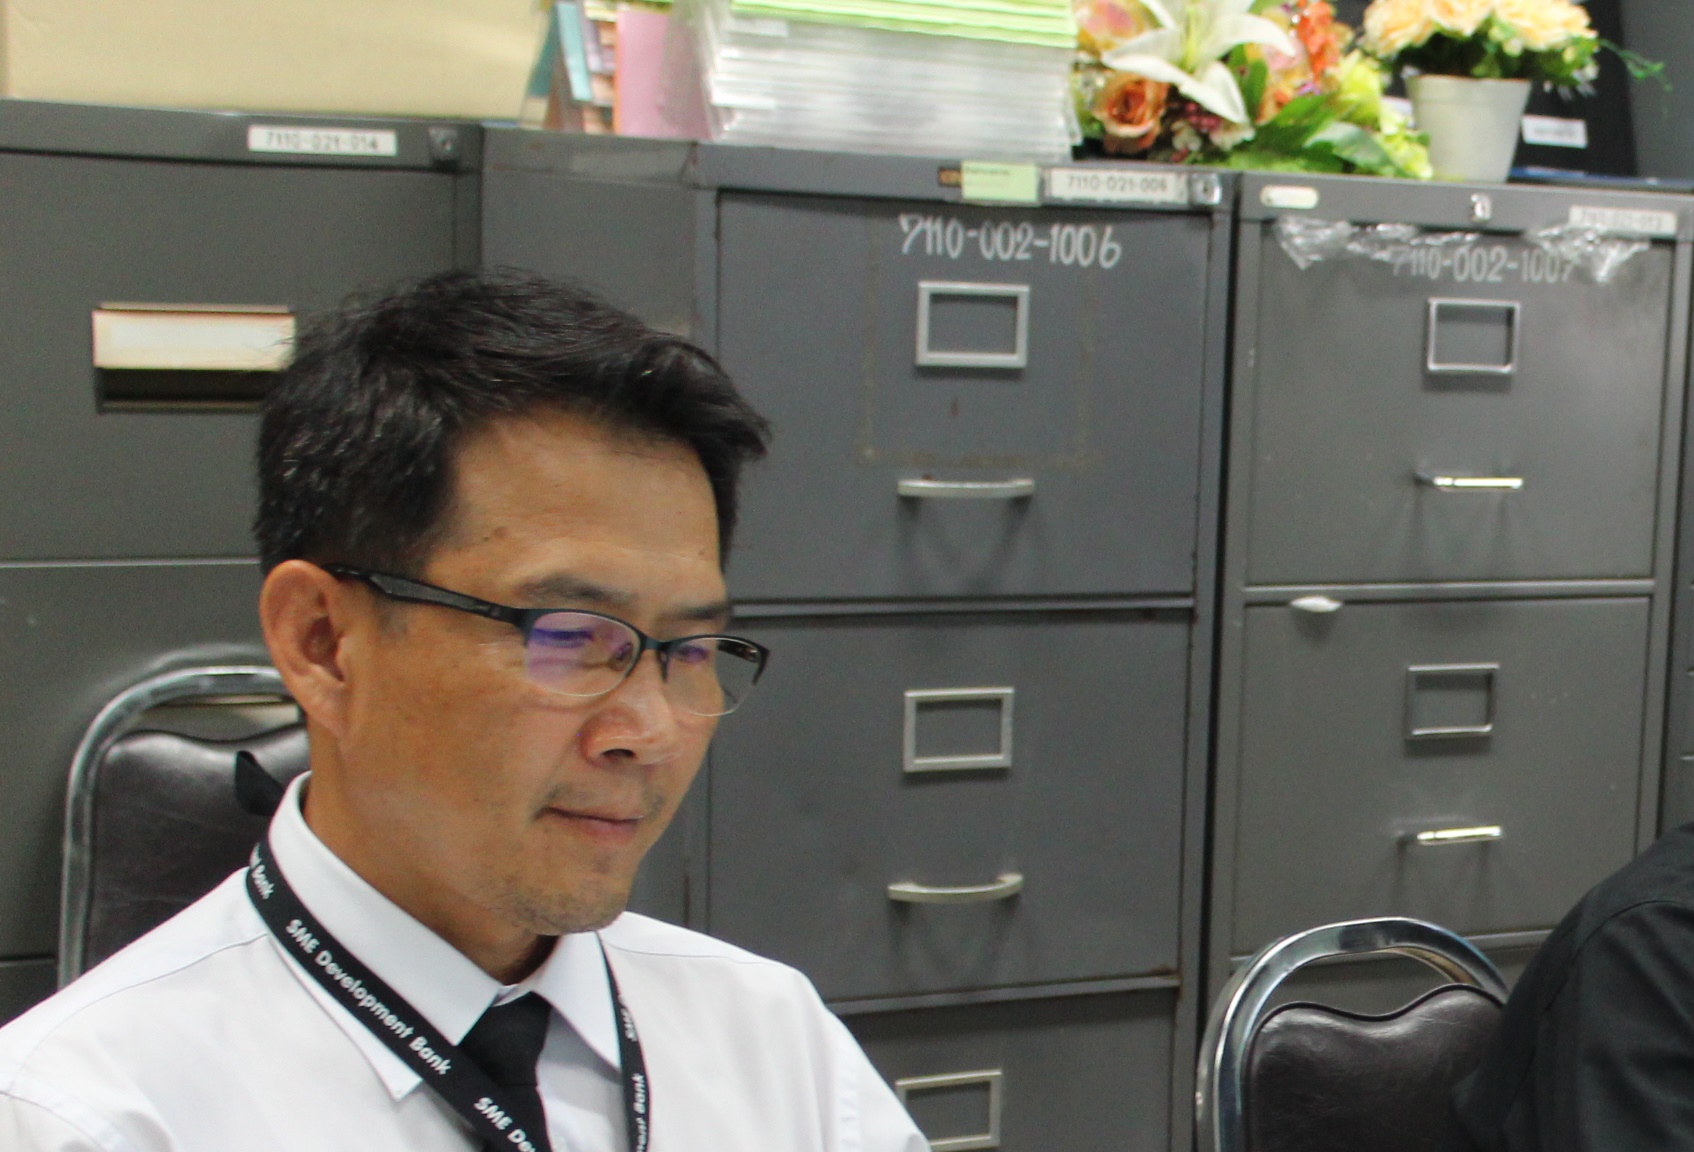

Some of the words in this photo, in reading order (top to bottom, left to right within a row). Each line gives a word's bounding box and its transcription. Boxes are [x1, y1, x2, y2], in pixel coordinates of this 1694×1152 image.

[898, 213, 1122, 269] 7110-002-1006
[285, 919, 320, 953] SME
[315, 950, 414, 1038] Development
[409, 1036, 452, 1075] Bank
[474, 1097, 513, 1130] SME
